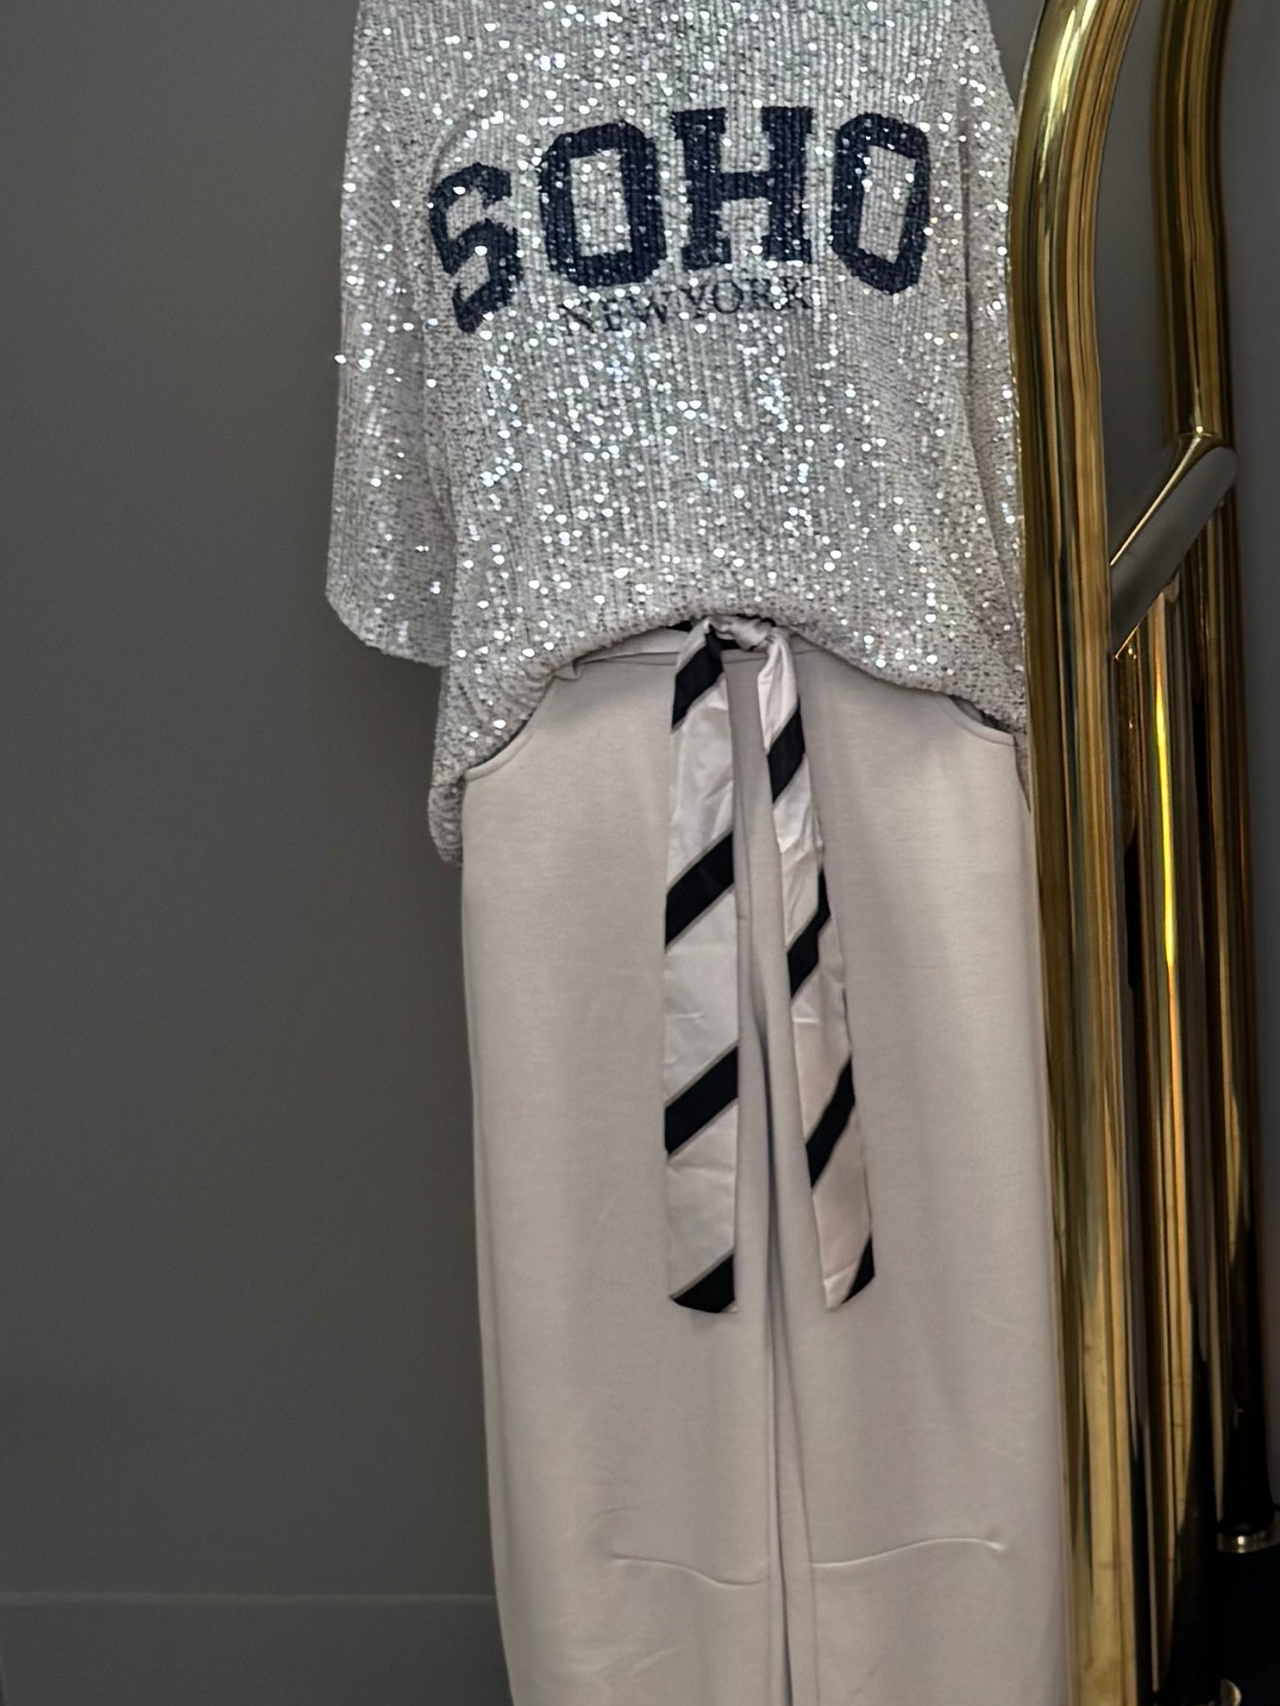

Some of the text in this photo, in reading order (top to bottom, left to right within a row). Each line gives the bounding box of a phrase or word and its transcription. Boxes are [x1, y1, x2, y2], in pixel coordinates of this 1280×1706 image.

[428, 106, 931, 333] SOHO
[558, 276, 813, 335] NEW YORK
